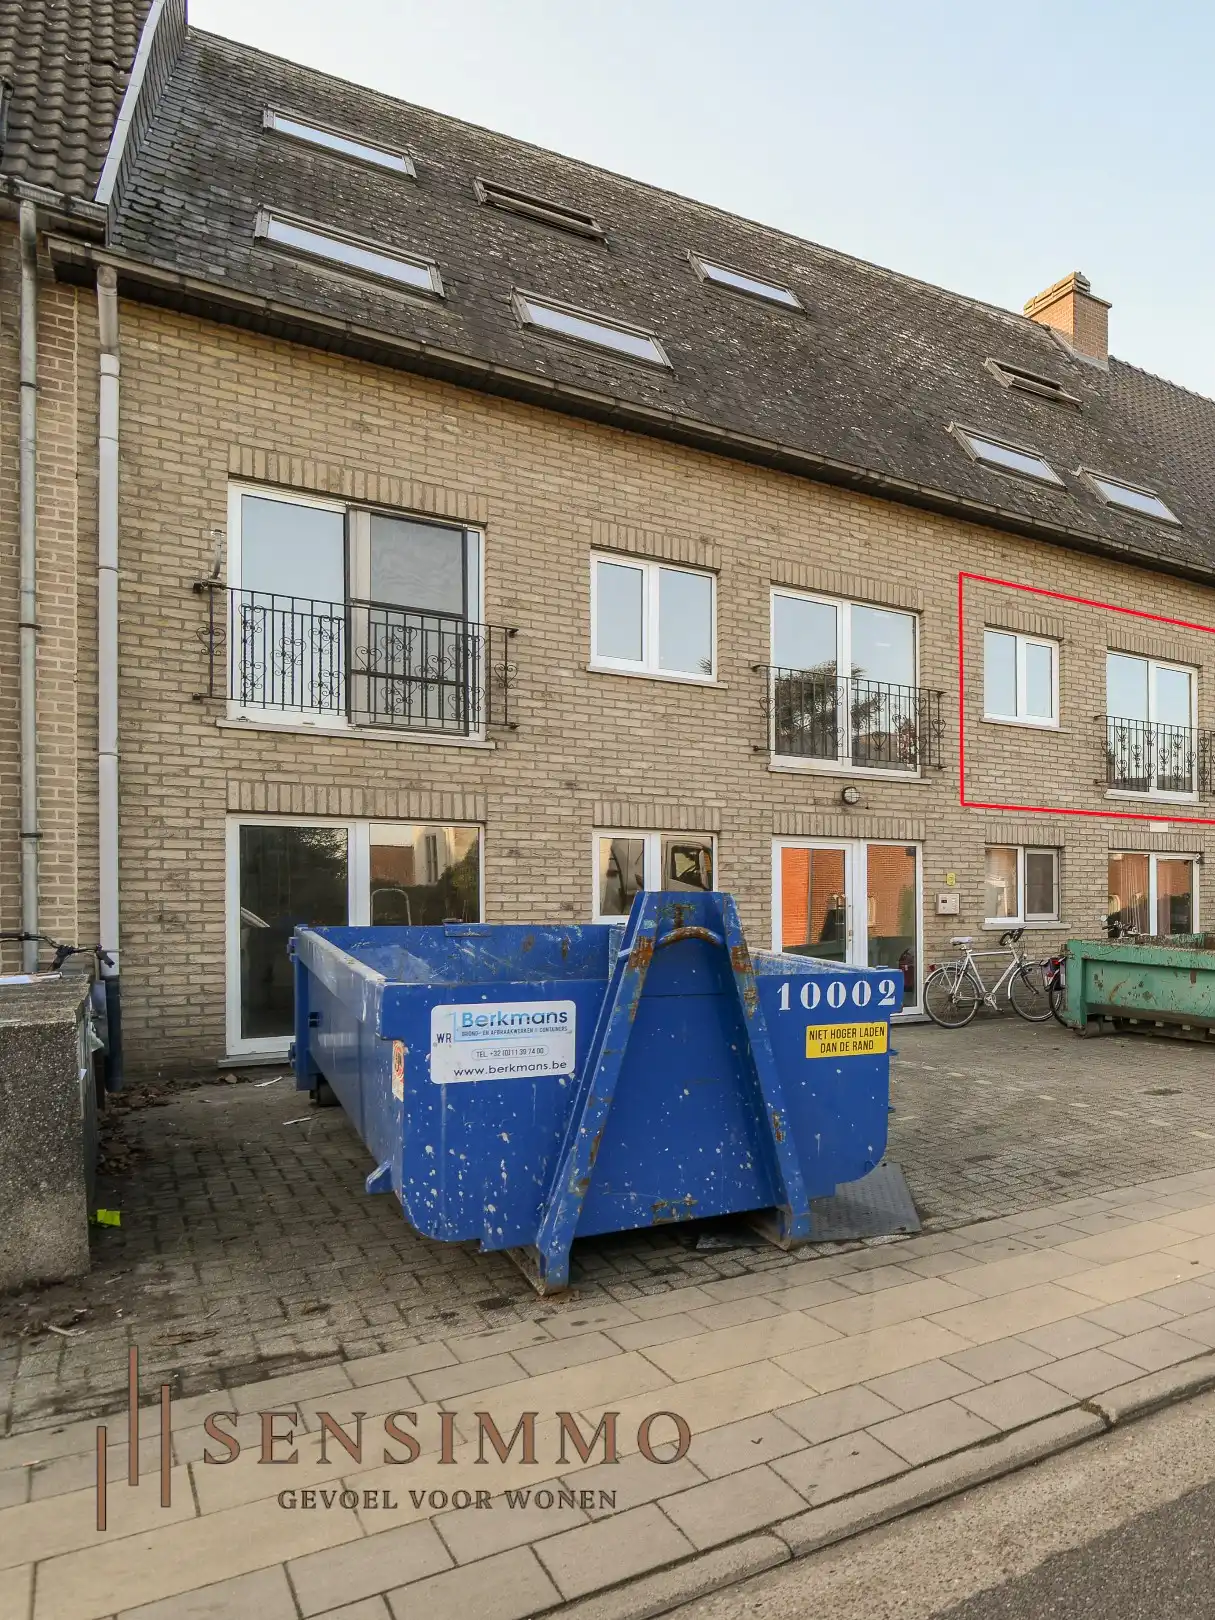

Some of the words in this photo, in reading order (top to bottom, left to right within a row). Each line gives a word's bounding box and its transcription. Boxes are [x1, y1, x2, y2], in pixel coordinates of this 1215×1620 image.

[776, 979, 896, 1011] 10002
[462, 1010, 568, 1028] Berkmans
[539, 1025, 568, 1033] CONTAINERS
[809, 1029, 828, 1041] NIET
[830, 1027, 857, 1040] HOGER
[859, 1026, 885, 1038] LADEN
[436, 1033, 452, 1044] WR
[490, 1049, 501, 1057] +32
[820, 1042, 837, 1053] DAN
[839, 1041, 850, 1052] DE
[852, 1040, 874, 1051] RAND
[453, 1060, 567, 1077] www.berkmans.be
